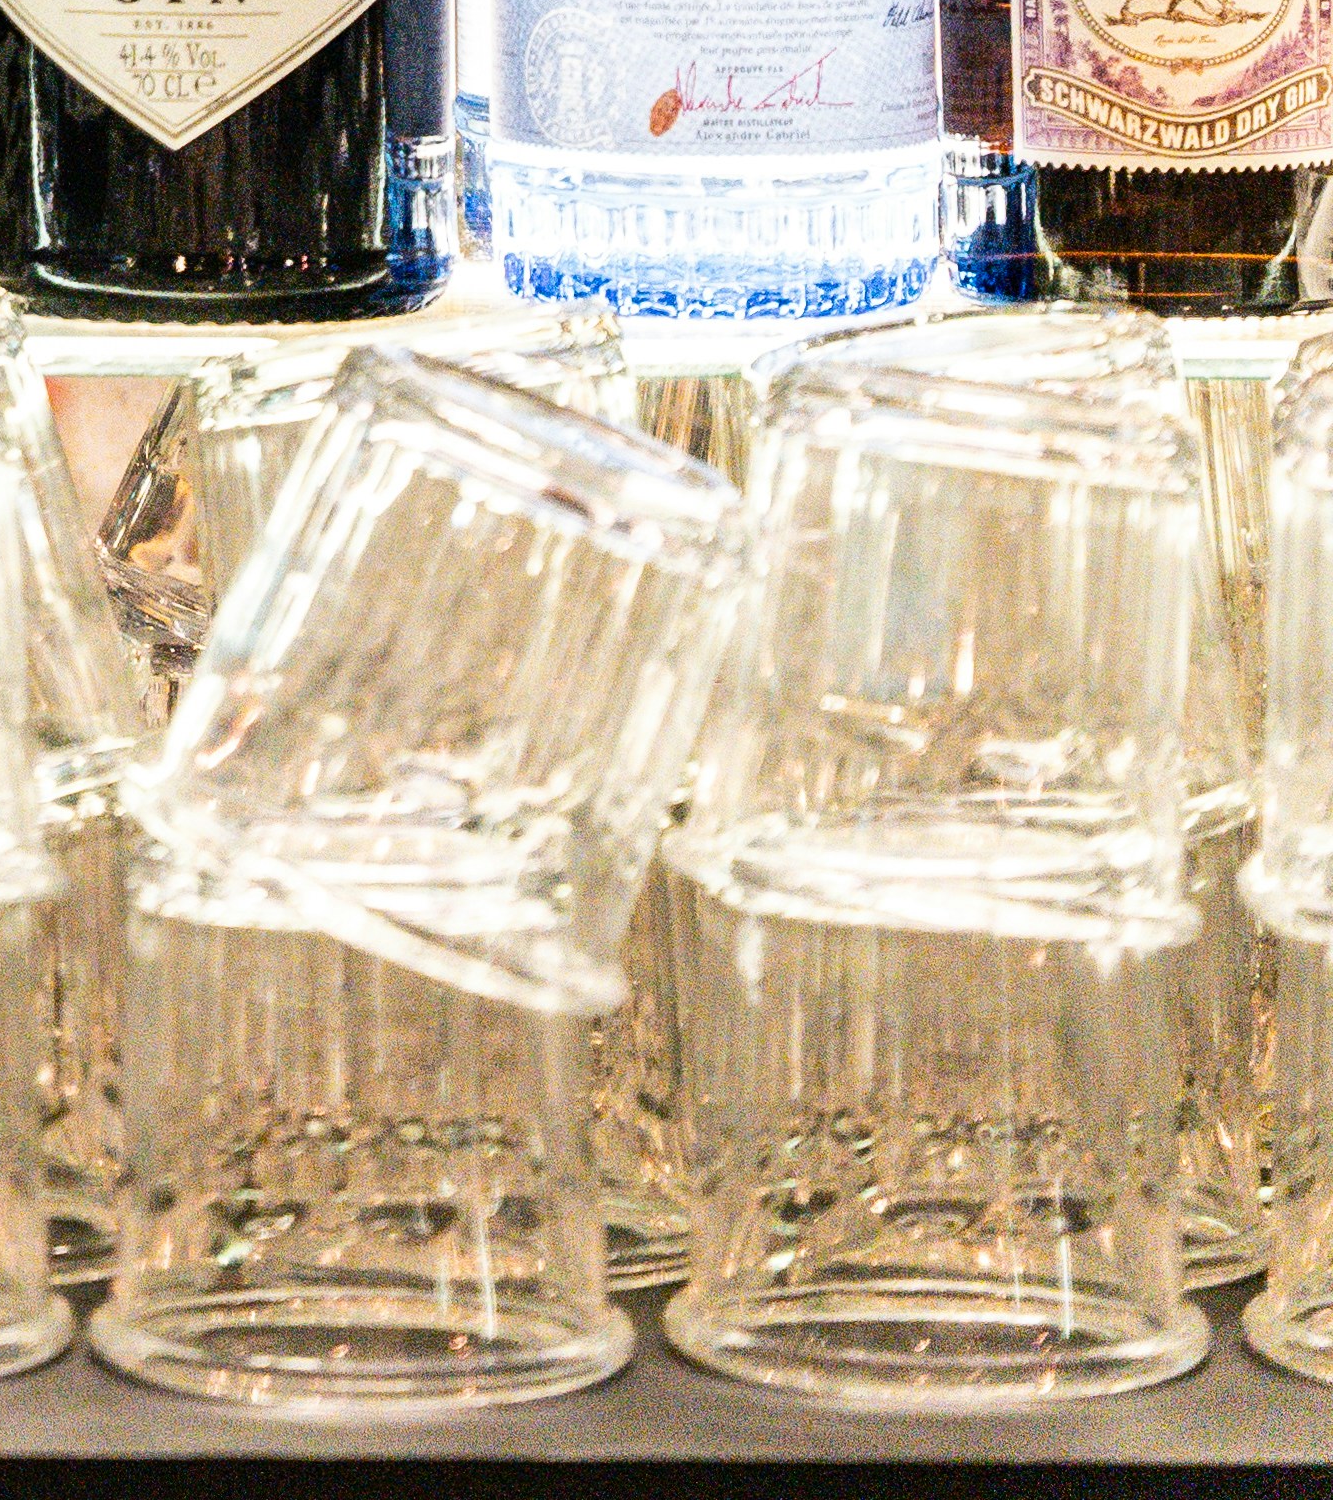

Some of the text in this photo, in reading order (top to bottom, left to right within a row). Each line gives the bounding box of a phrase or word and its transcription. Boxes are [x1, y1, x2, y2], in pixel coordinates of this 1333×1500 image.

[1036, 74, 1324, 149] SCHWARZWALD DRY GIN
